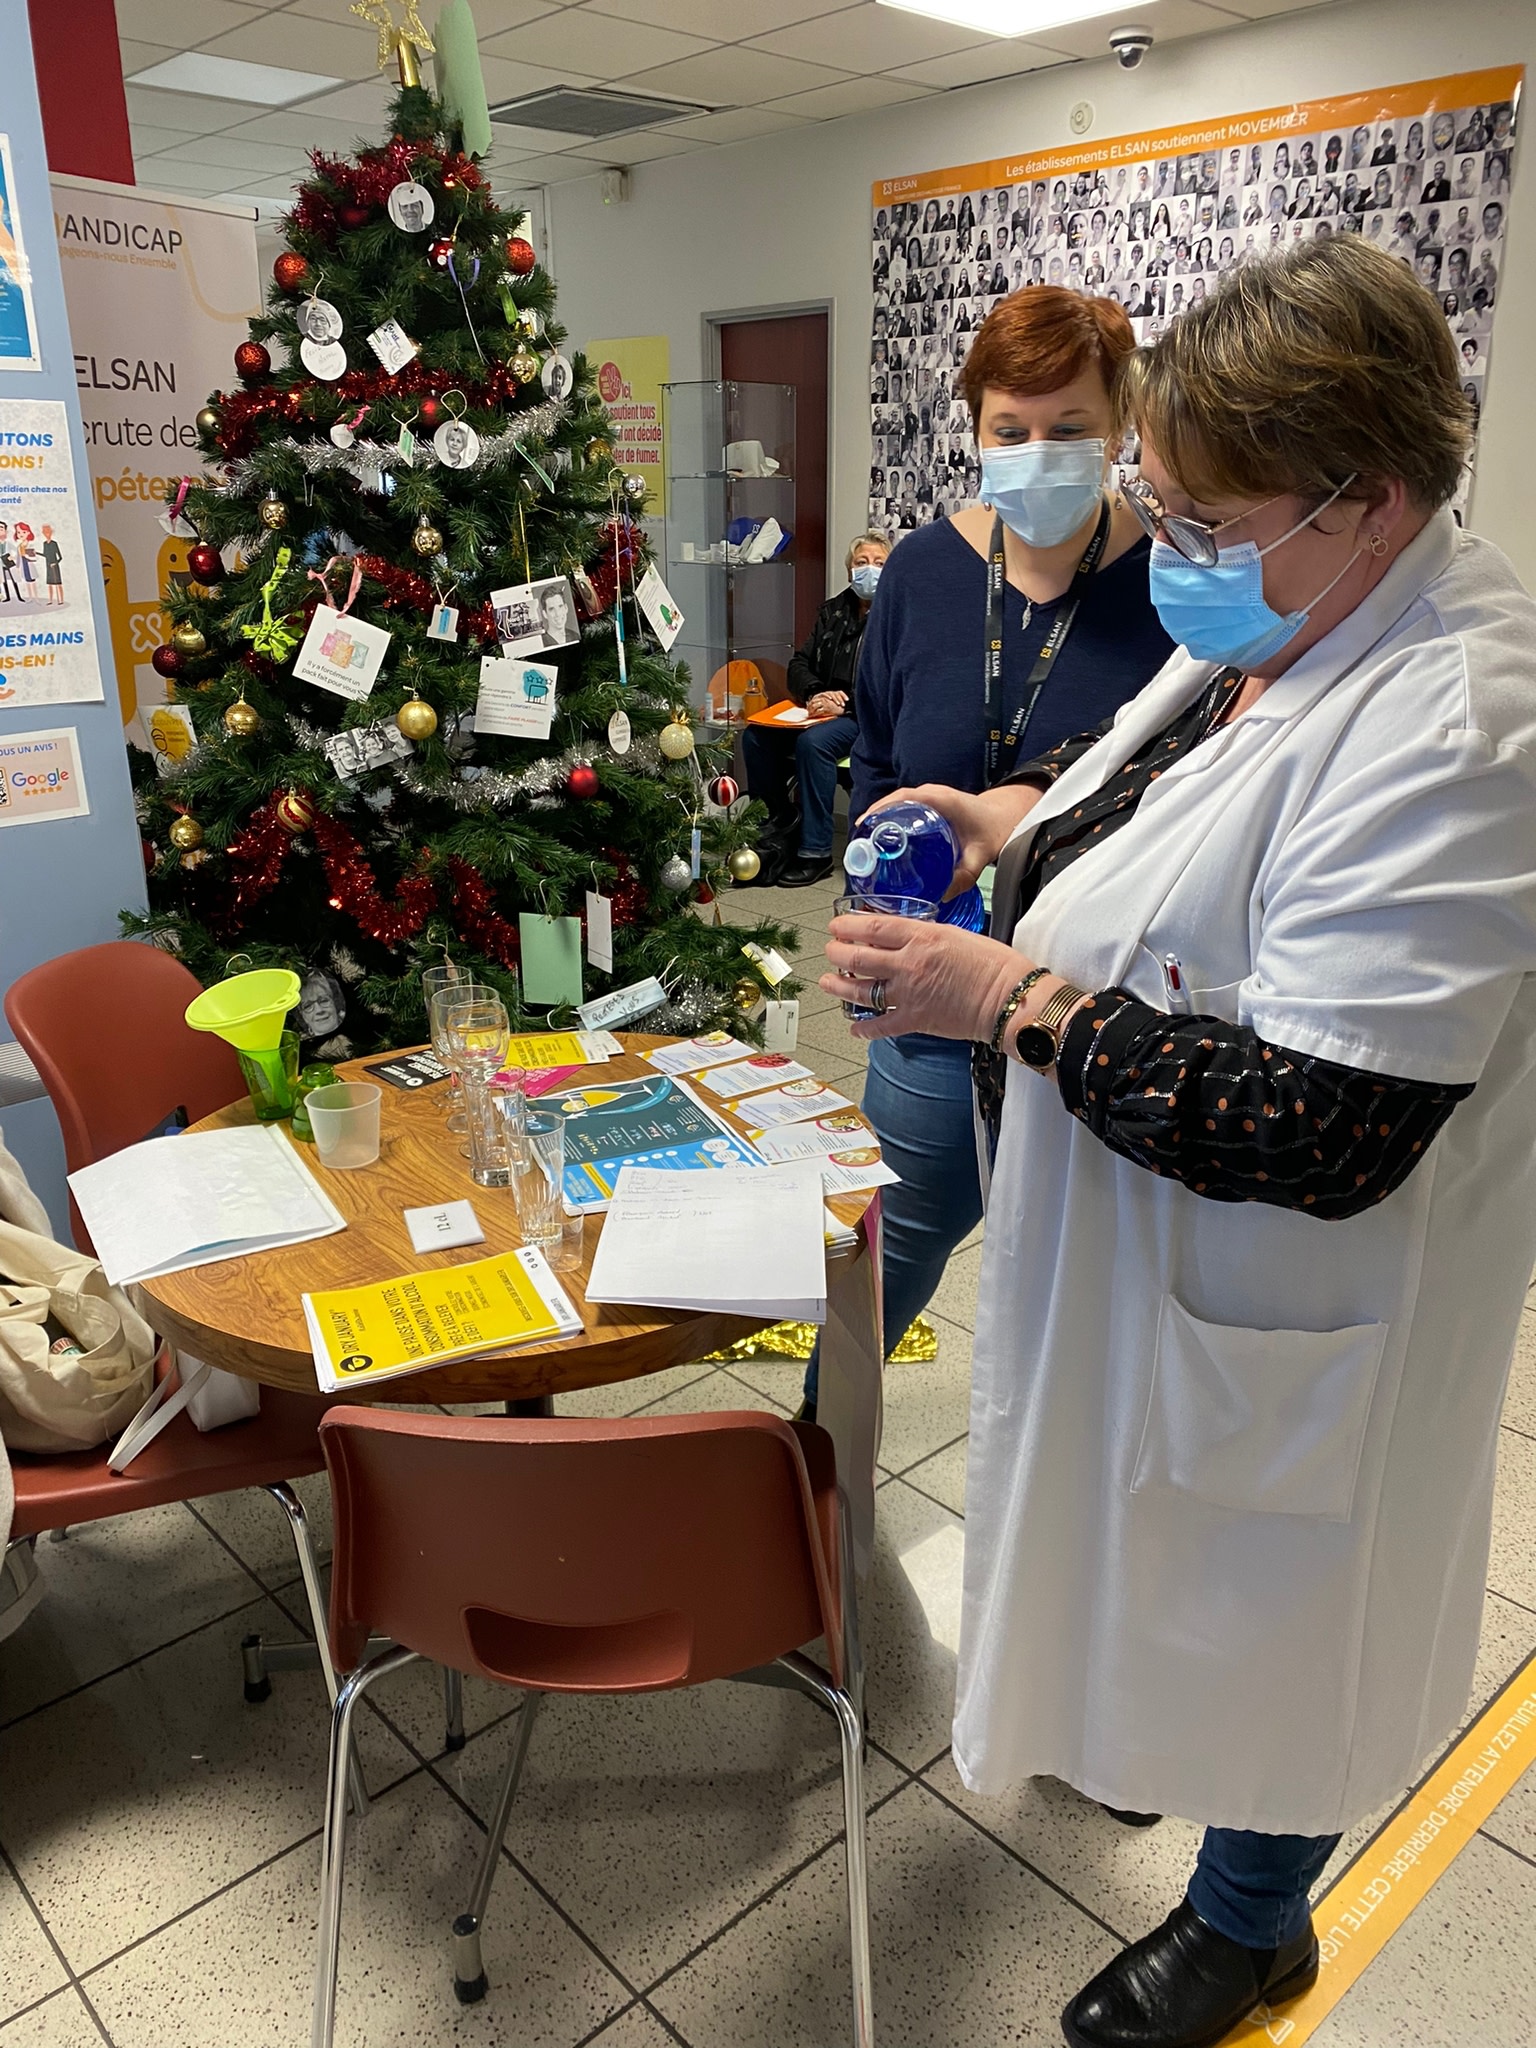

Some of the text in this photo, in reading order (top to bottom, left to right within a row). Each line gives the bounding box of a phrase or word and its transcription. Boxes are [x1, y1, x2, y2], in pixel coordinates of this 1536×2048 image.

[1006, 112, 1308, 178] Les établissements ELSAN soutiennent MOVEMBER
[893, 180, 918, 192] ELSAN
[74, 355, 176, 393] ELSAN
[610, 404, 656, 421] soutient tous
[624, 427, 636, 441] ont
[636, 423, 662, 442] décidé
[625, 449, 635, 463] de
[0, 496, 22, 504] anté
[1084, 536, 1101, 563] ELSAN
[993, 563, 1001, 589] ELSAN
[30, 631, 84, 646] MAINS
[1046, 621, 1062, 648] ELSAN
[301, 667, 357, 694] pack fait pour vous
[351, 679, 361, 687] un
[1009, 707, 1025, 734] ELSAN
[17, 746, 32, 754] UN
[33, 743, 53, 752] AVIS
[990, 741, 999, 768] ELSAN
[12, 767, 70, 787] Google
[381, 1288, 424, 1358] UNE PAUSE DANS VOTRE
[401, 1282, 445, 1352] CONSOMMATION D'ALCOOL
[435, 1304, 456, 1326] RELEVER
[330, 1311, 360, 1354] DRY JANUARY
[463, 1324, 479, 1337] DÉFI
[469, 1335, 483, 1343] LE
[1436, 1743, 1503, 1819] ATTENDRE
[1380, 1809, 1453, 1888] DERRIÈRE
[1339, 1874, 1394, 1933] CETTE
